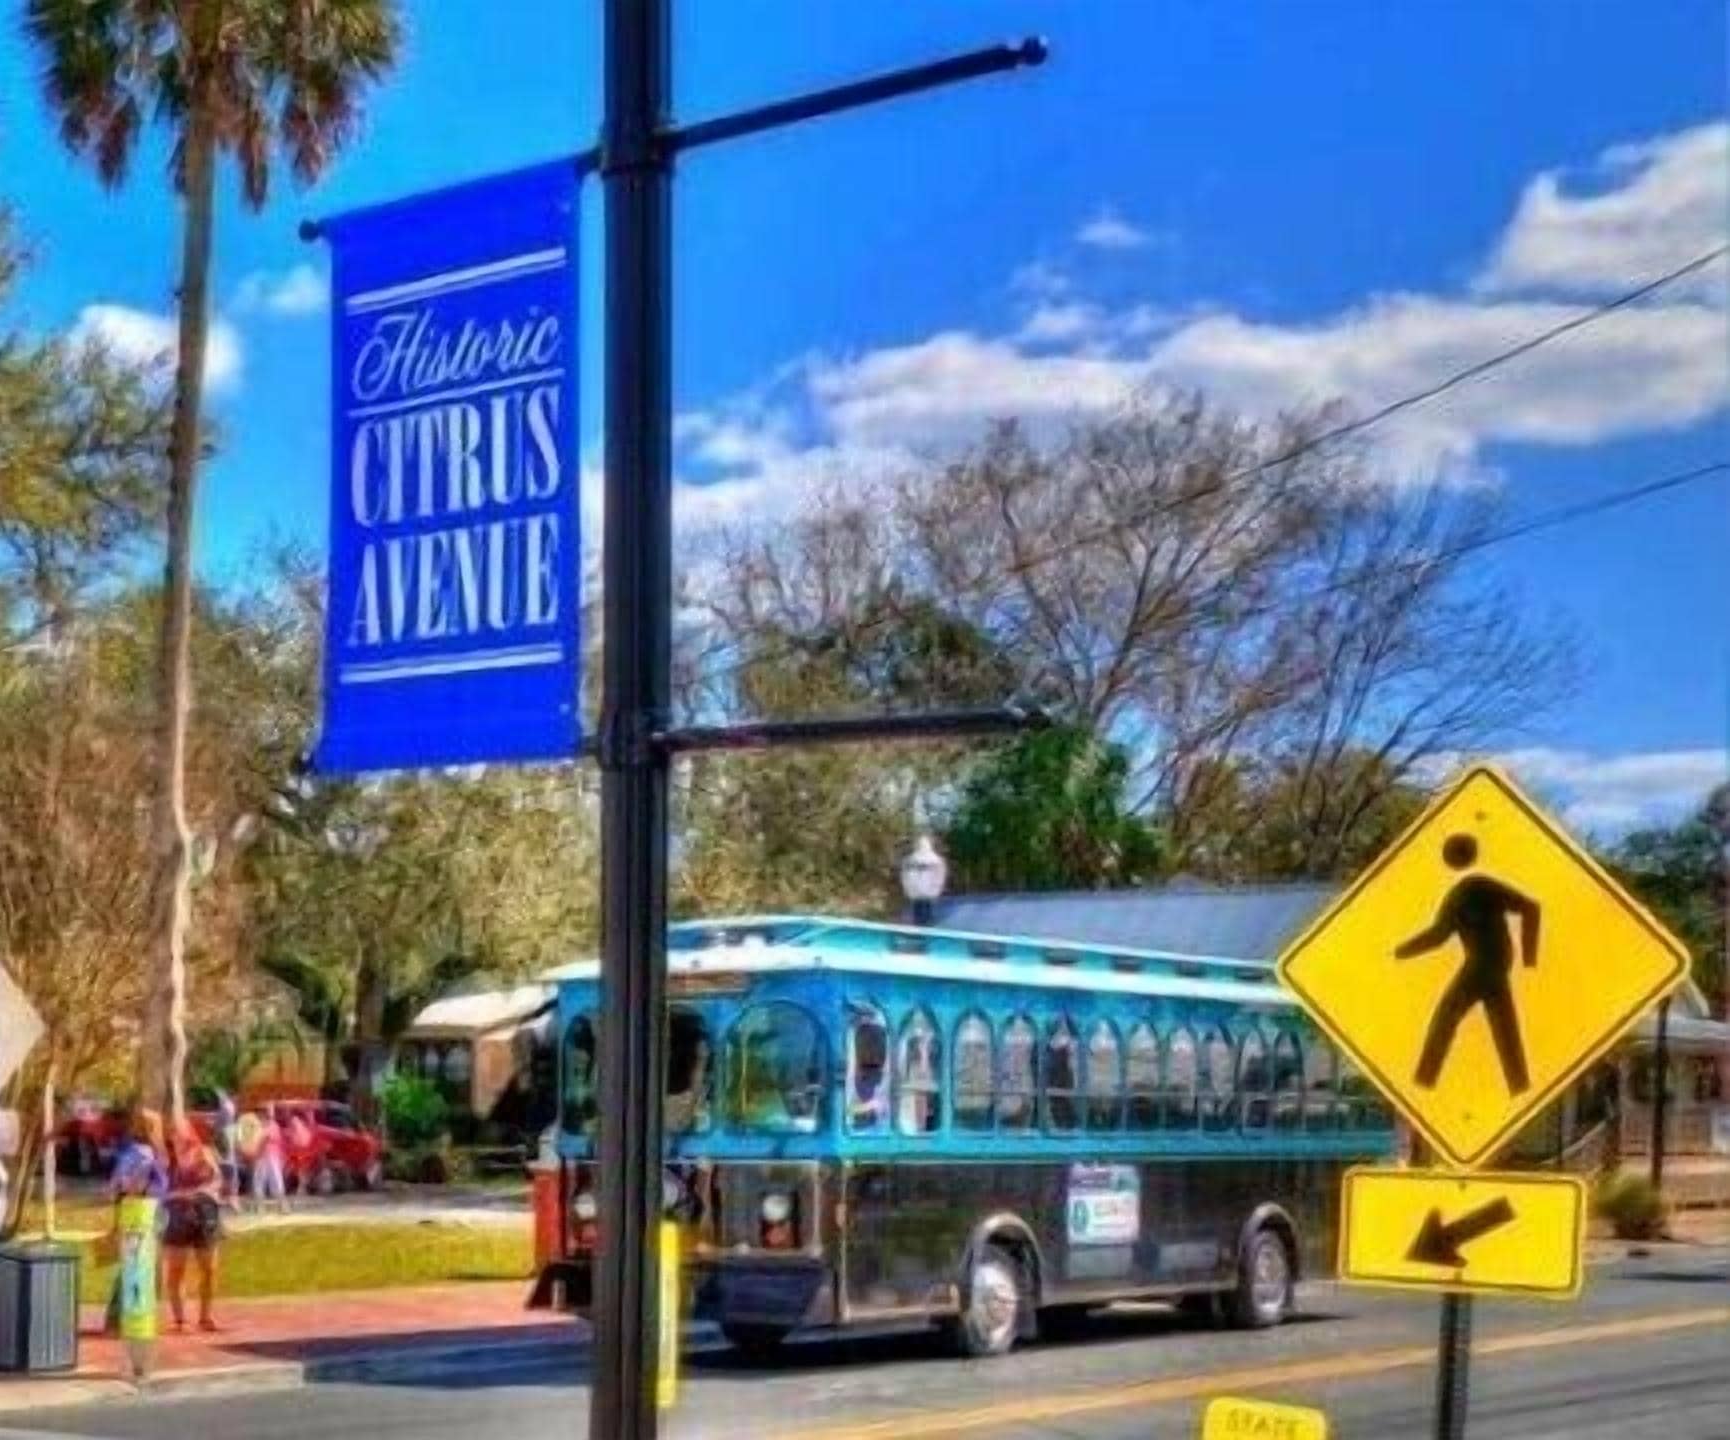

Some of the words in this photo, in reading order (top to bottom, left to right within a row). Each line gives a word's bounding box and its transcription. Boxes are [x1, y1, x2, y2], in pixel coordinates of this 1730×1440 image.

[351, 308, 560, 400] Historic
[351, 384, 560, 528] CITRUS
[347, 512, 559, 647] AVENUE
